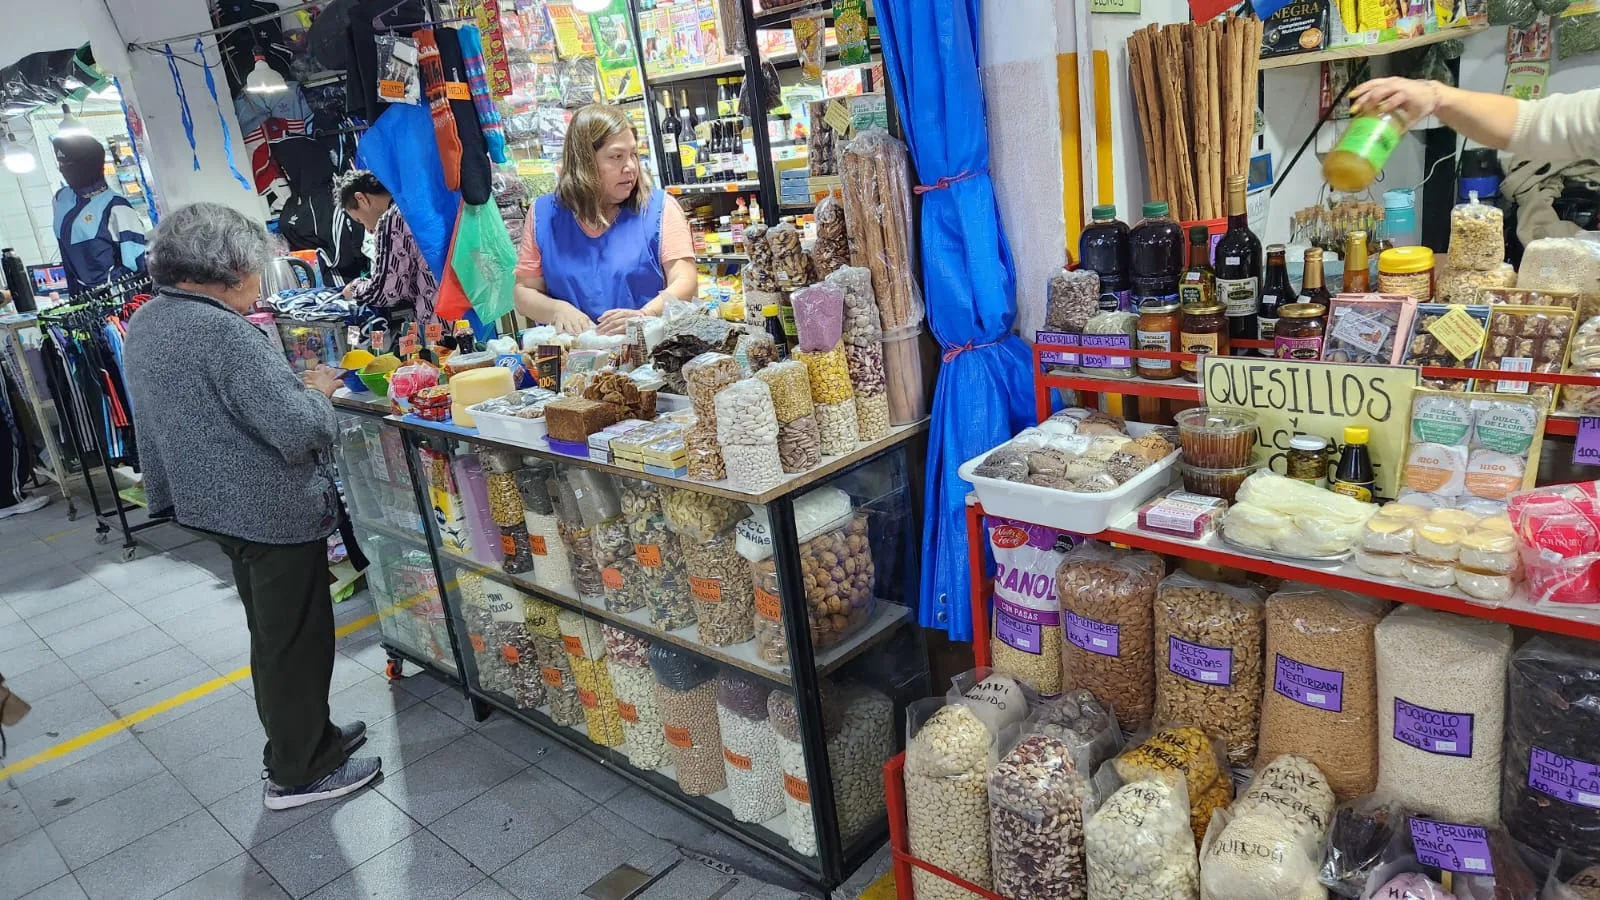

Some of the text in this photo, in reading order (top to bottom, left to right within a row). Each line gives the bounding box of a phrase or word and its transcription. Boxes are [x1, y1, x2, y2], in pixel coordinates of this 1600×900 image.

[1271, 2, 1320, 20] NEGRA
[1083, 336, 1126, 347] RICA RICA
[539, 376, 556, 389] 100%
[1209, 362, 1392, 423] QUESILLOS
[1430, 407, 1457, 417] DULCE
[1433, 414, 1463, 423] LECHE
[1493, 415, 1521, 425] DULCE
[1497, 421, 1526, 432] LECHE
[1480, 463, 1507, 472] HIGO
[995, 562, 1057, 600] RANOL
[1001, 602, 1039, 621] CON PASAS
[998, 612, 1034, 634] GRANOLA
[1067, 612, 1119, 635] ALMENDRAS
[1172, 638, 1208, 660] NUECES
[1180, 653, 1223, 669] PELADAS
[1278, 656, 1305, 673] SOJA
[1280, 667, 1339, 694] TEXTURIZADA
[1398, 702, 1460, 728] POCHOCLO
[1414, 722, 1458, 739] QUINOA
[1423, 736, 1431, 747] $
[1533, 749, 1576, 775] FLOR
[1534, 763, 1600, 793] JAMAICA
[1412, 822, 1488, 839] AJI PERUANO
[1412, 835, 1456, 855] PANCA
[1452, 856, 1461, 870] $
